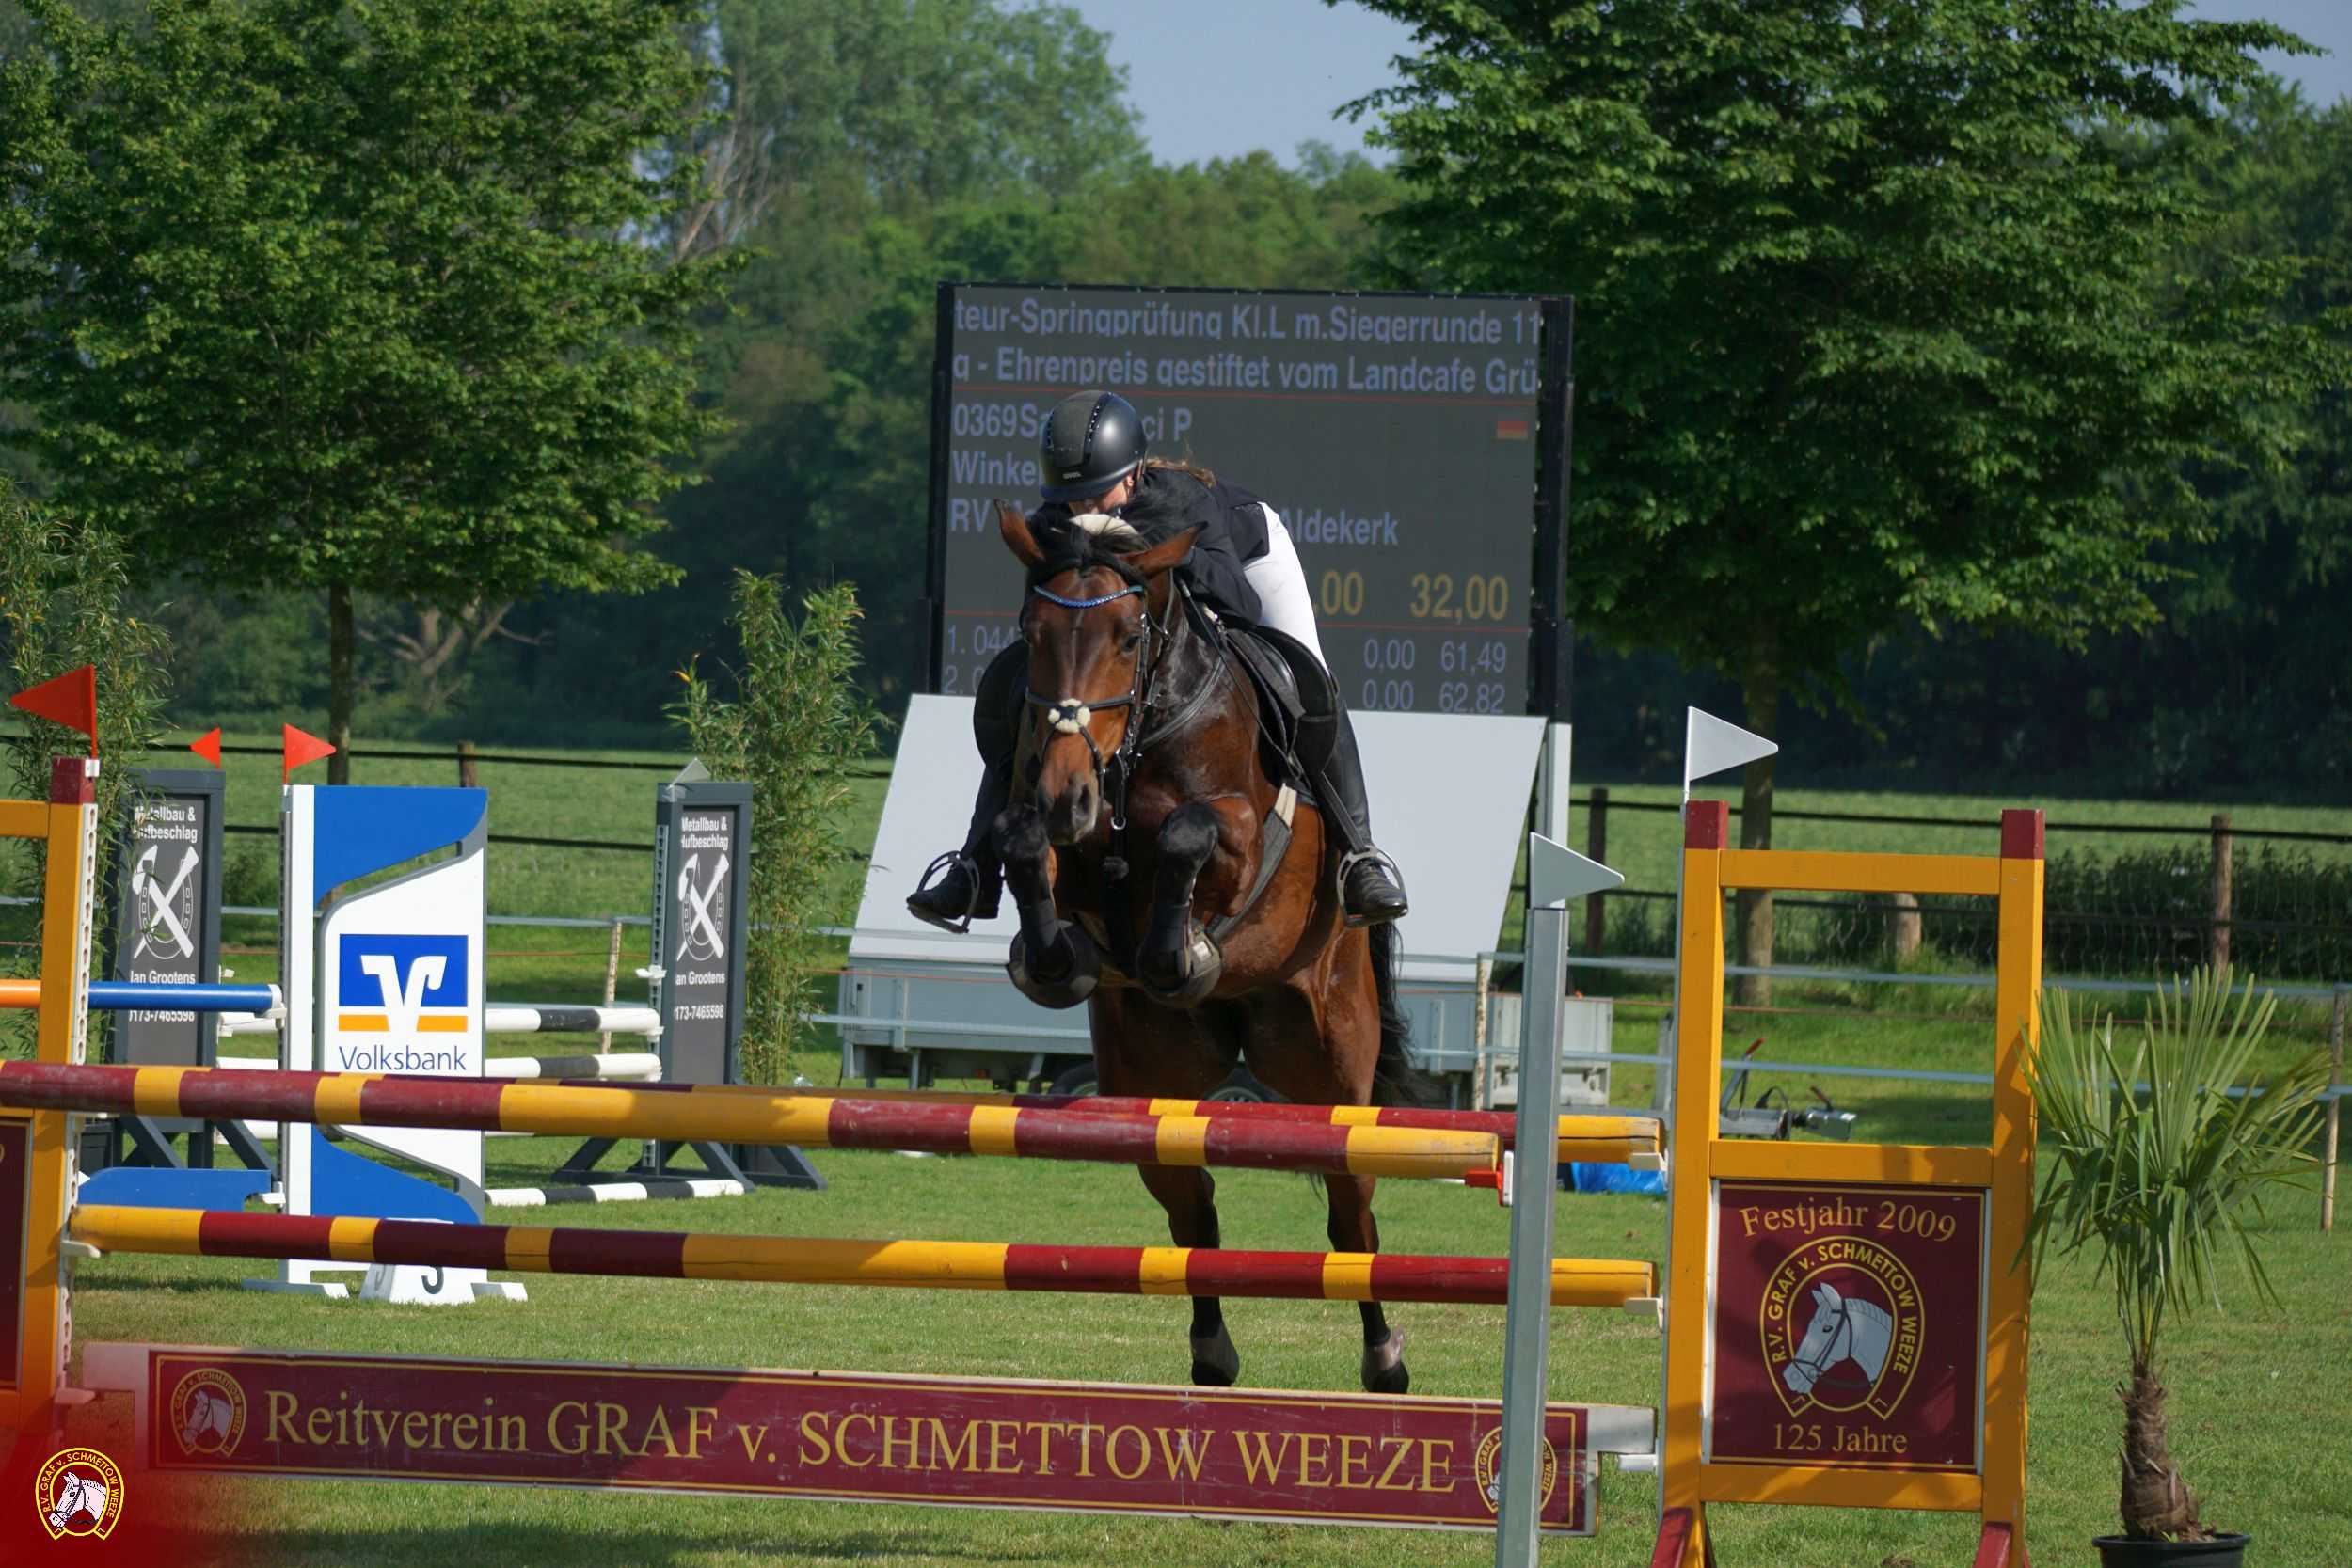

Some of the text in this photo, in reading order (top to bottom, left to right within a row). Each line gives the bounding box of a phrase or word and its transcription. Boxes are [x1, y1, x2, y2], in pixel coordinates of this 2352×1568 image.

[1295, 305, 1502, 344] m.Siegerrunde
[997, 346, 1148, 385] Ehrenpreis
[1157, 351, 1270, 388] gestiftet
[1279, 361, 1338, 390] vom
[1347, 356, 1476, 393] Landcafe
[1174, 407, 1192, 441] P
[950, 499, 990, 532] RV
[1410, 573, 1509, 623] 32,00
[1364, 639, 1416, 672] 0,00
[1440, 641, 1506, 674] 61,49
[188, 806, 197, 821] &
[721, 816, 728, 832] &
[150, 970, 196, 985] Grootens
[688, 970, 725, 985] Grootens
[675, 1004, 724, 1021] 173-7465598
[339, 1045, 467, 1071] Volksbank
[1740, 1196, 1956, 1242] Festjahr 2009
[1768, 1268, 1798, 1320] GRAF
[1817, 1243, 1915, 1307] SCHMETTOW
[1893, 1316, 1917, 1374] WEEZE
[264, 1389, 1456, 1493] Reitverein GRAF v. SCHMETTOW WEEZE
[1772, 1423, 1908, 1454] 125 Jahre
